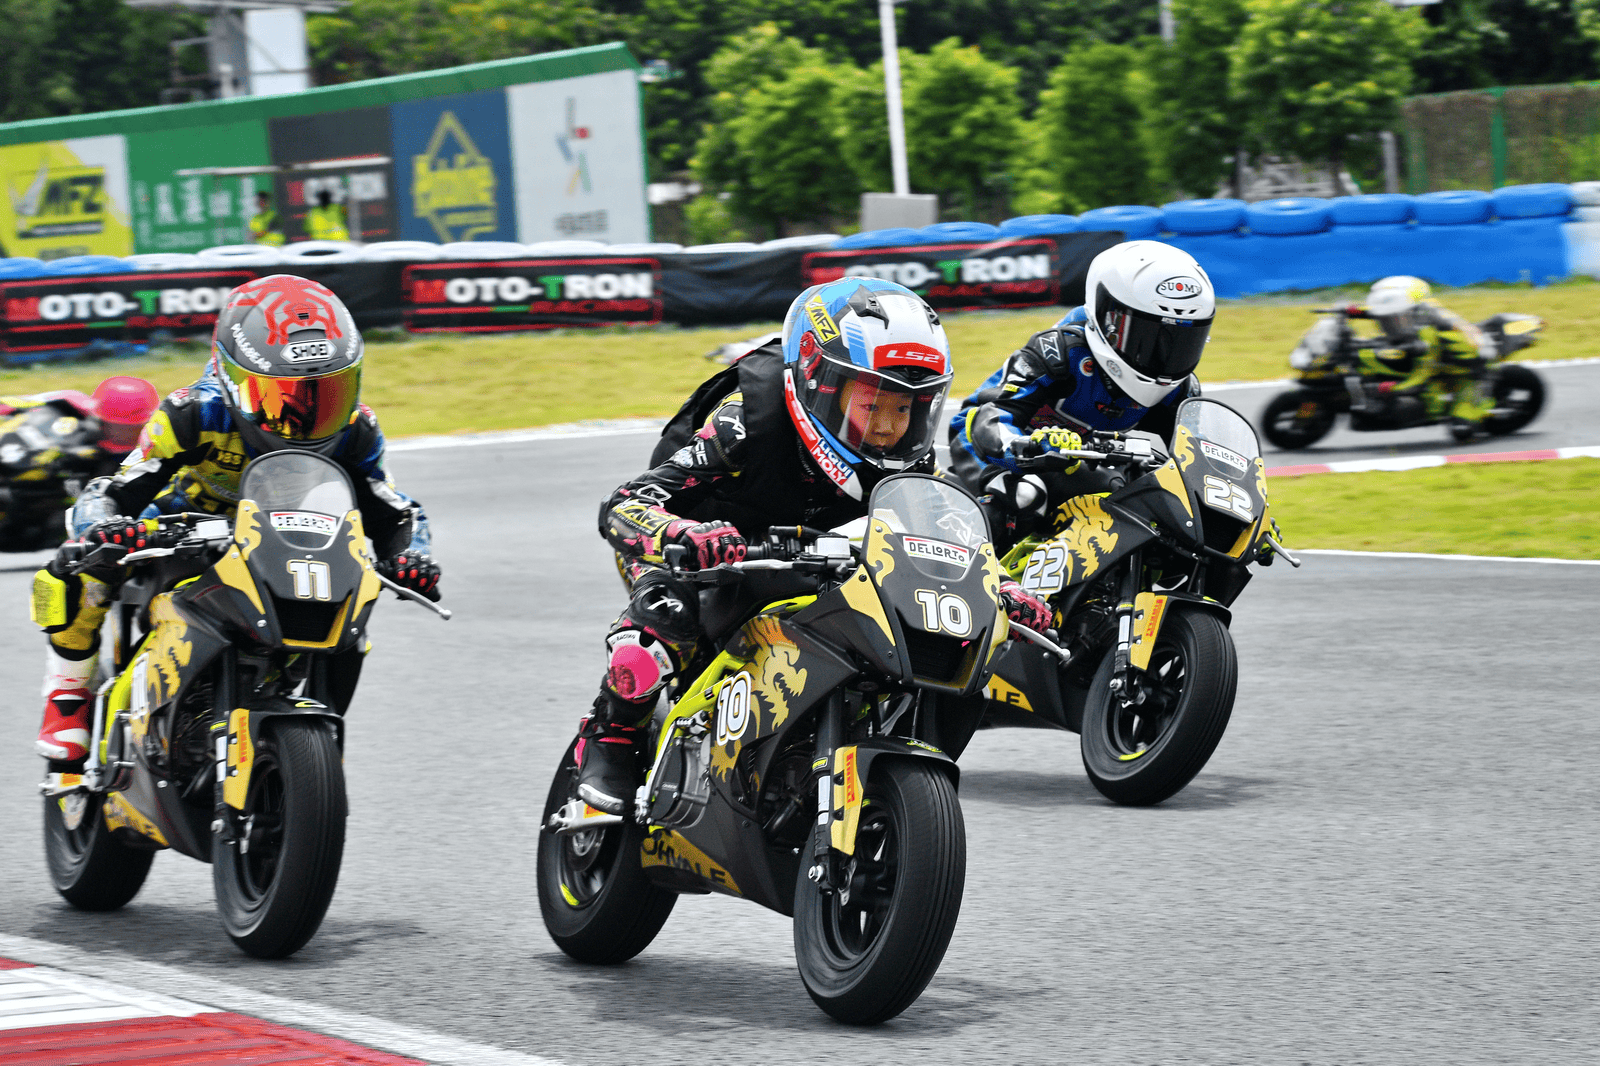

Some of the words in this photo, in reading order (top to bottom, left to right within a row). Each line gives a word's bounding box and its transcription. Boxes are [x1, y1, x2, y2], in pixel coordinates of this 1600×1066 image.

[811, 308, 837, 340] MFZ
[886, 349, 941, 363] LS2
[812, 446, 846, 482] MOLY
[818, 439, 852, 478] LIQUI
[1203, 474, 1254, 524] 22
[909, 541, 966, 563] DELLORTO
[1021, 541, 1069, 594] 22
[286, 558, 332, 602] 11
[914, 587, 973, 638] 10
[716, 671, 752, 746] 10
